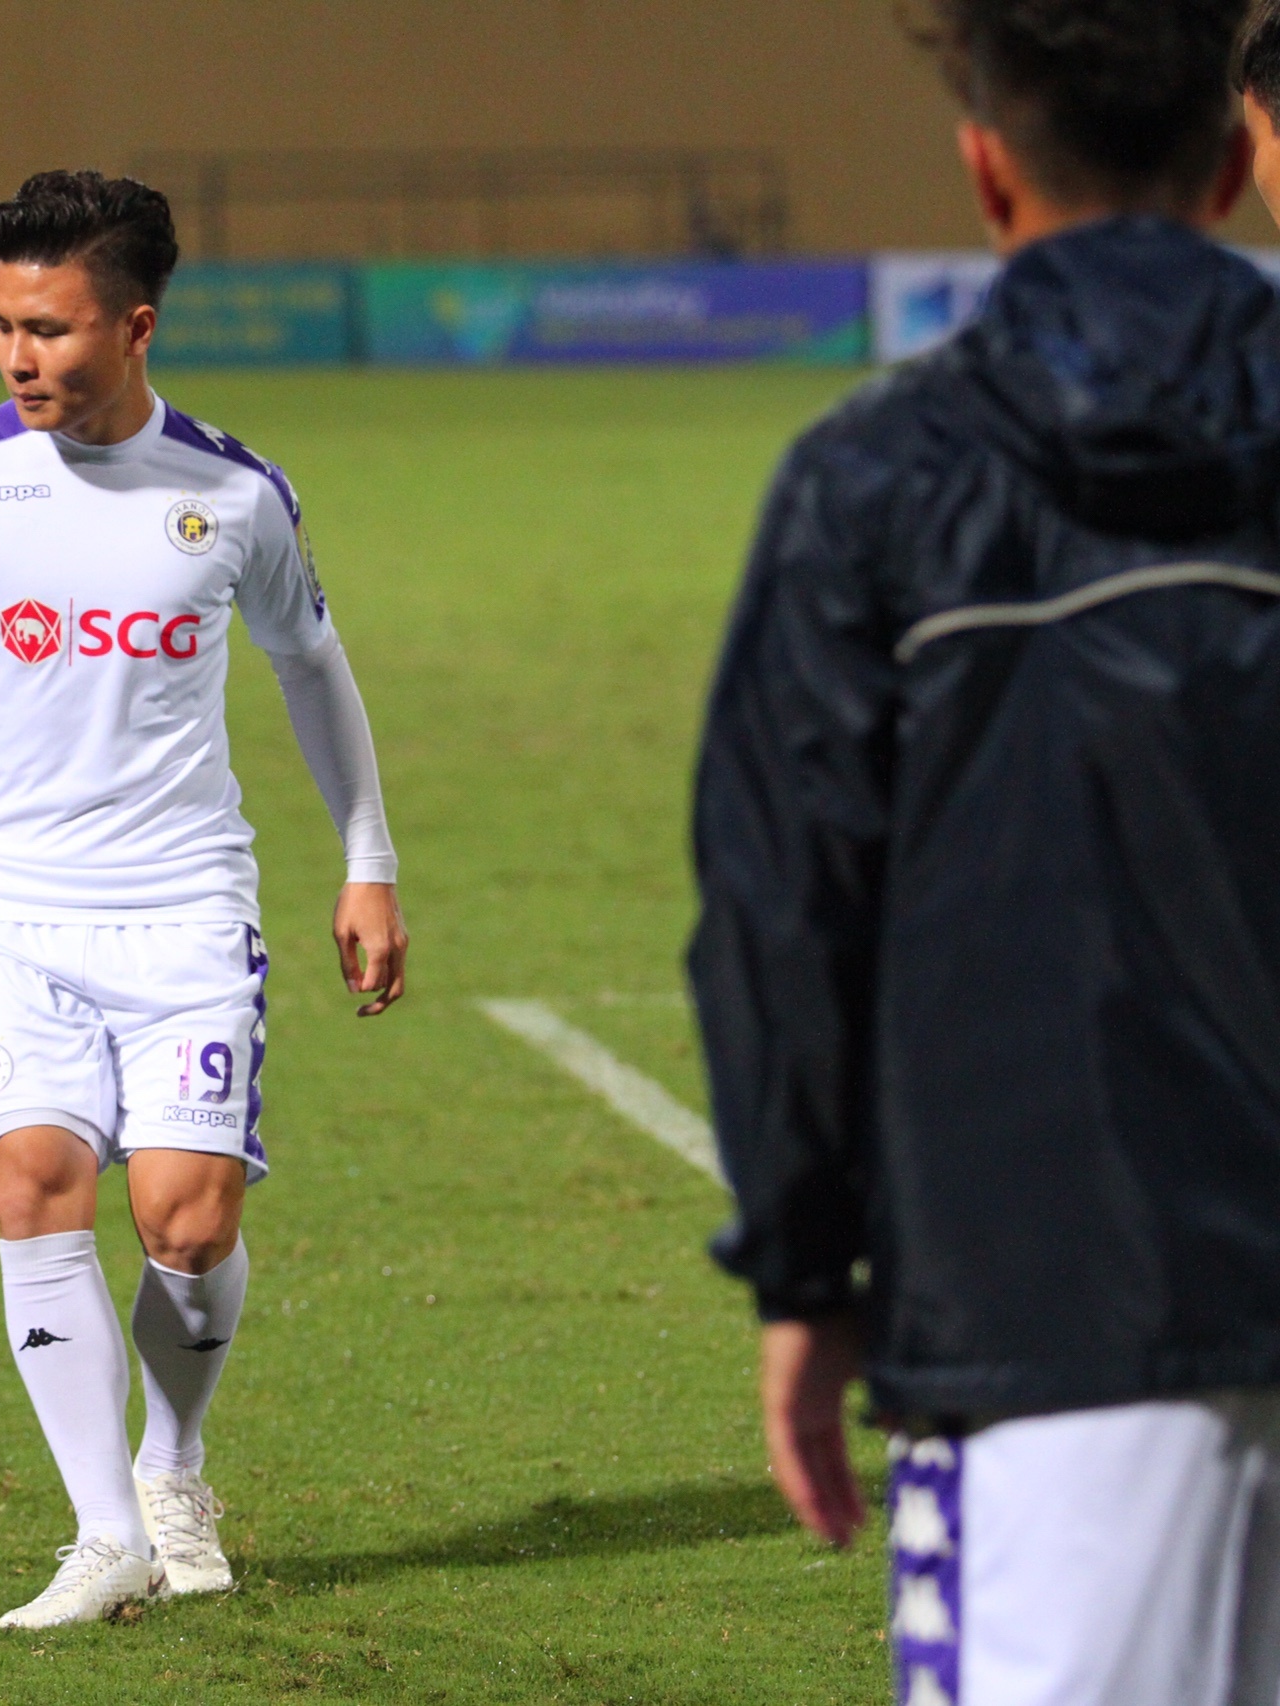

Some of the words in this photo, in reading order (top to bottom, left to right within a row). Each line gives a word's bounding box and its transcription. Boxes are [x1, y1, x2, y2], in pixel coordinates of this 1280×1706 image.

[79, 609, 201, 659] SCG
[177, 1039, 233, 1104] 19
[162, 1105, 237, 1128] Kappa
